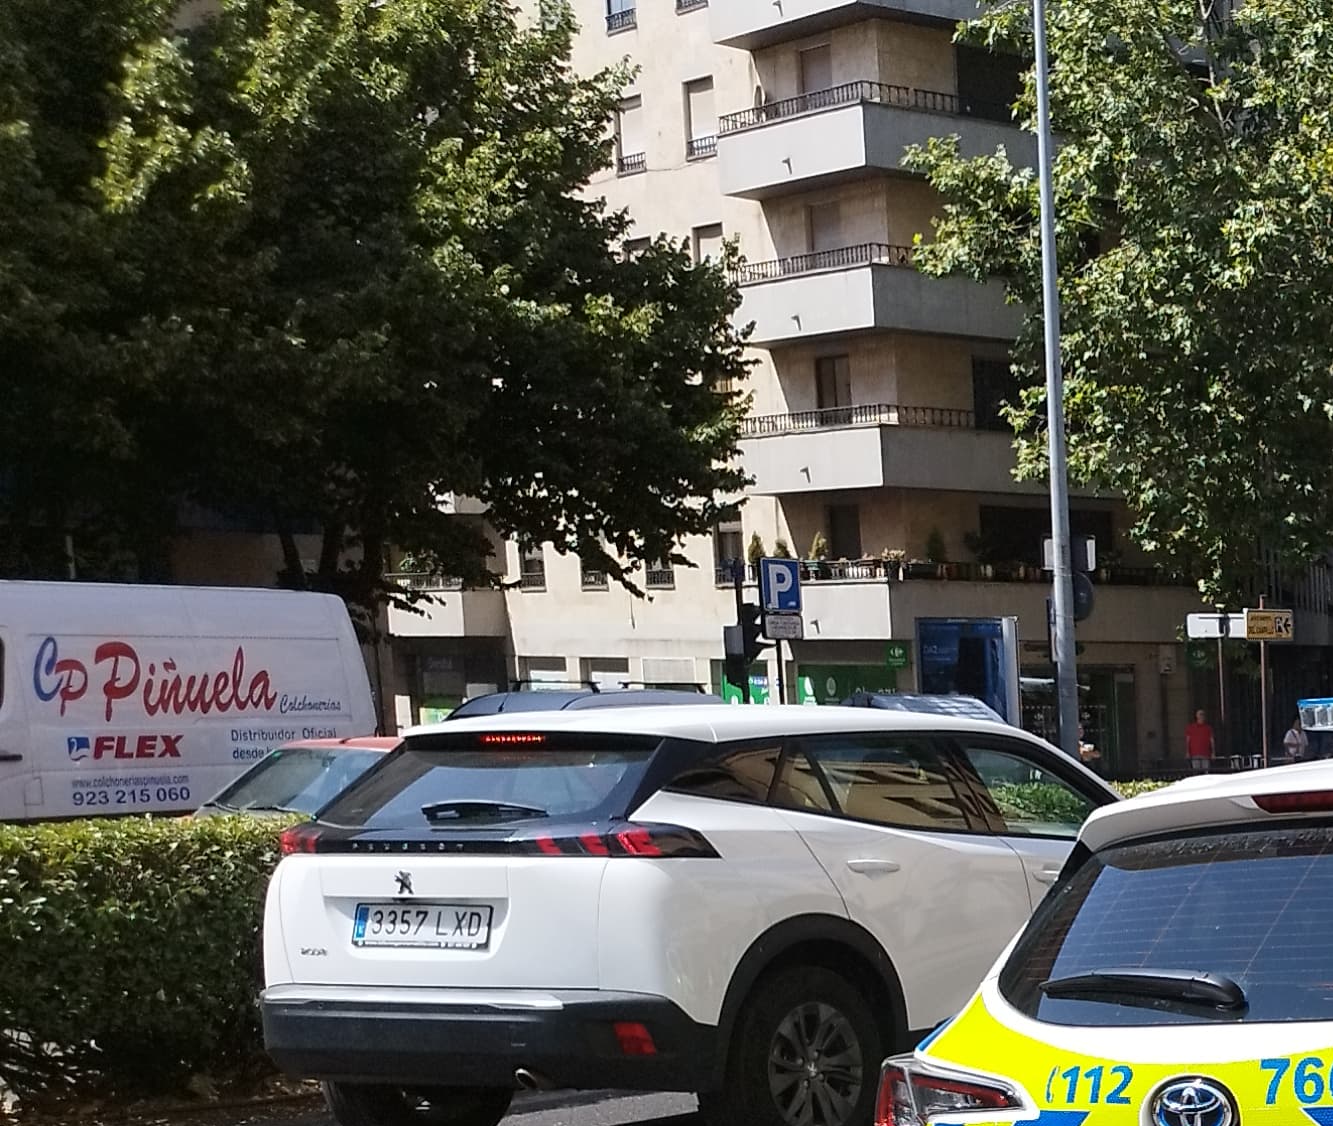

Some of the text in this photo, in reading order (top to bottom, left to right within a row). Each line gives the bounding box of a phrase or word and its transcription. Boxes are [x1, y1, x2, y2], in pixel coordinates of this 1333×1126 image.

[768, 564, 793, 609] P
[95, 641, 278, 722] Piñuela
[93, 734, 185, 760] FLEX
[230, 727, 337, 743] Distribuidor Oficial
[73, 786, 191, 807] 923 215 060
[371, 909, 429, 936] 3357
[435, 911, 482, 937] LXD
